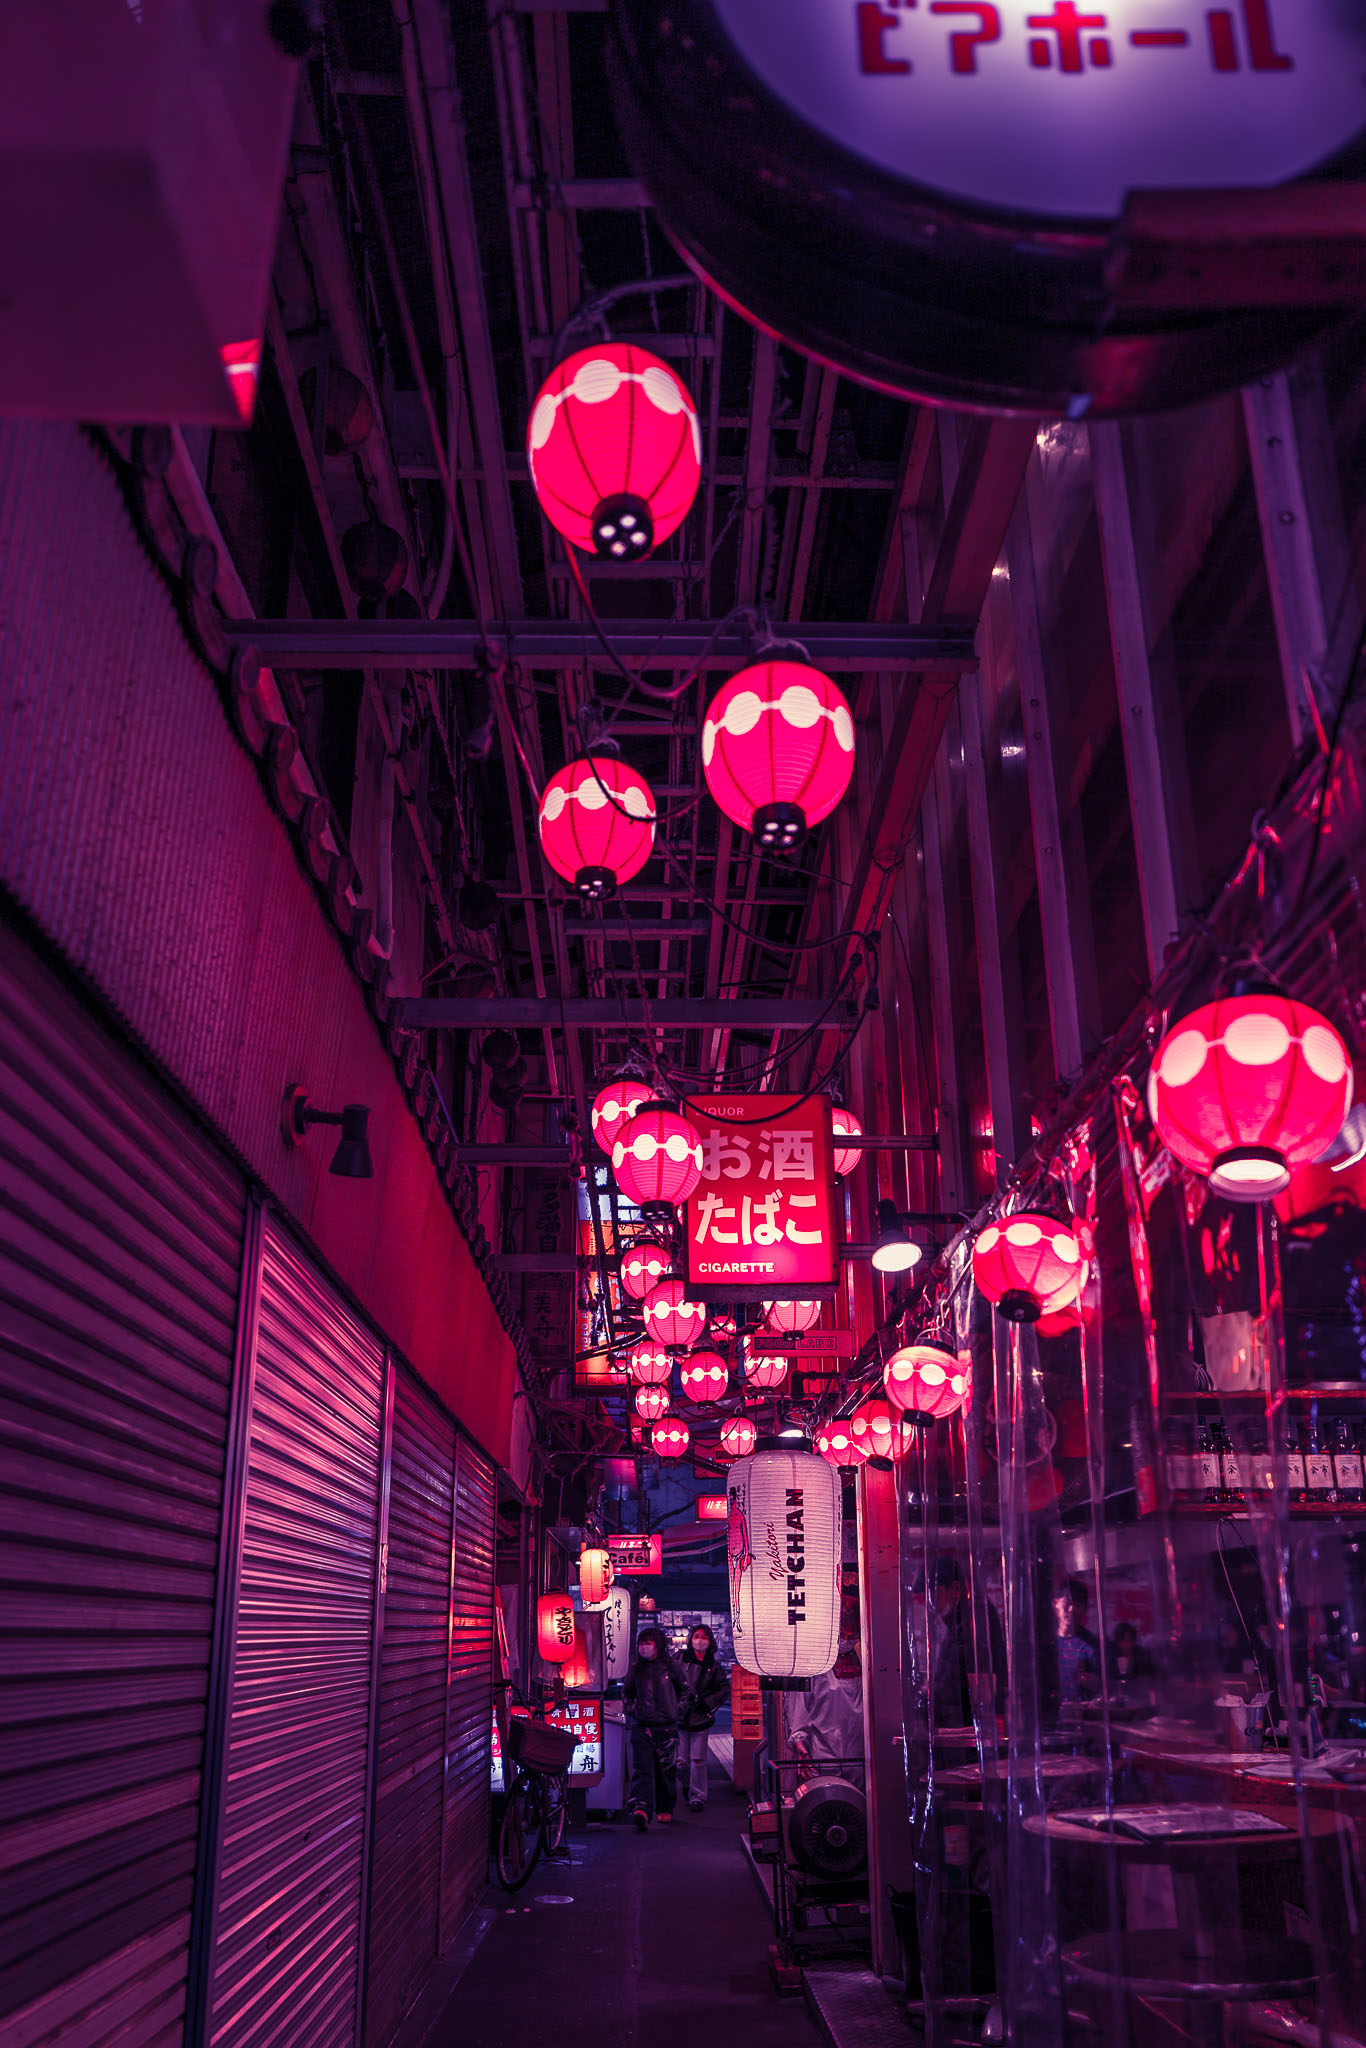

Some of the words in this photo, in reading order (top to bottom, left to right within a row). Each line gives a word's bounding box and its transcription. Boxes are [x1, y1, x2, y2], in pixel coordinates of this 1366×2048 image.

[857, 0, 1295, 76] ビアホール
[700, 1129, 815, 1181] お酒
[694, 1188, 823, 1246] たばこ
[698, 1262, 775, 1273] CIGARETTE
[798, 1338, 835, 1348] LABO
[609, 1552, 644, 1564] Café
[765, 1521, 788, 1581] Yakitori
[785, 1488, 806, 1626] TETCHAN
[554, 1606, 573, 1645] やきとり
[604, 1606, 616, 1664] てっちゃん
